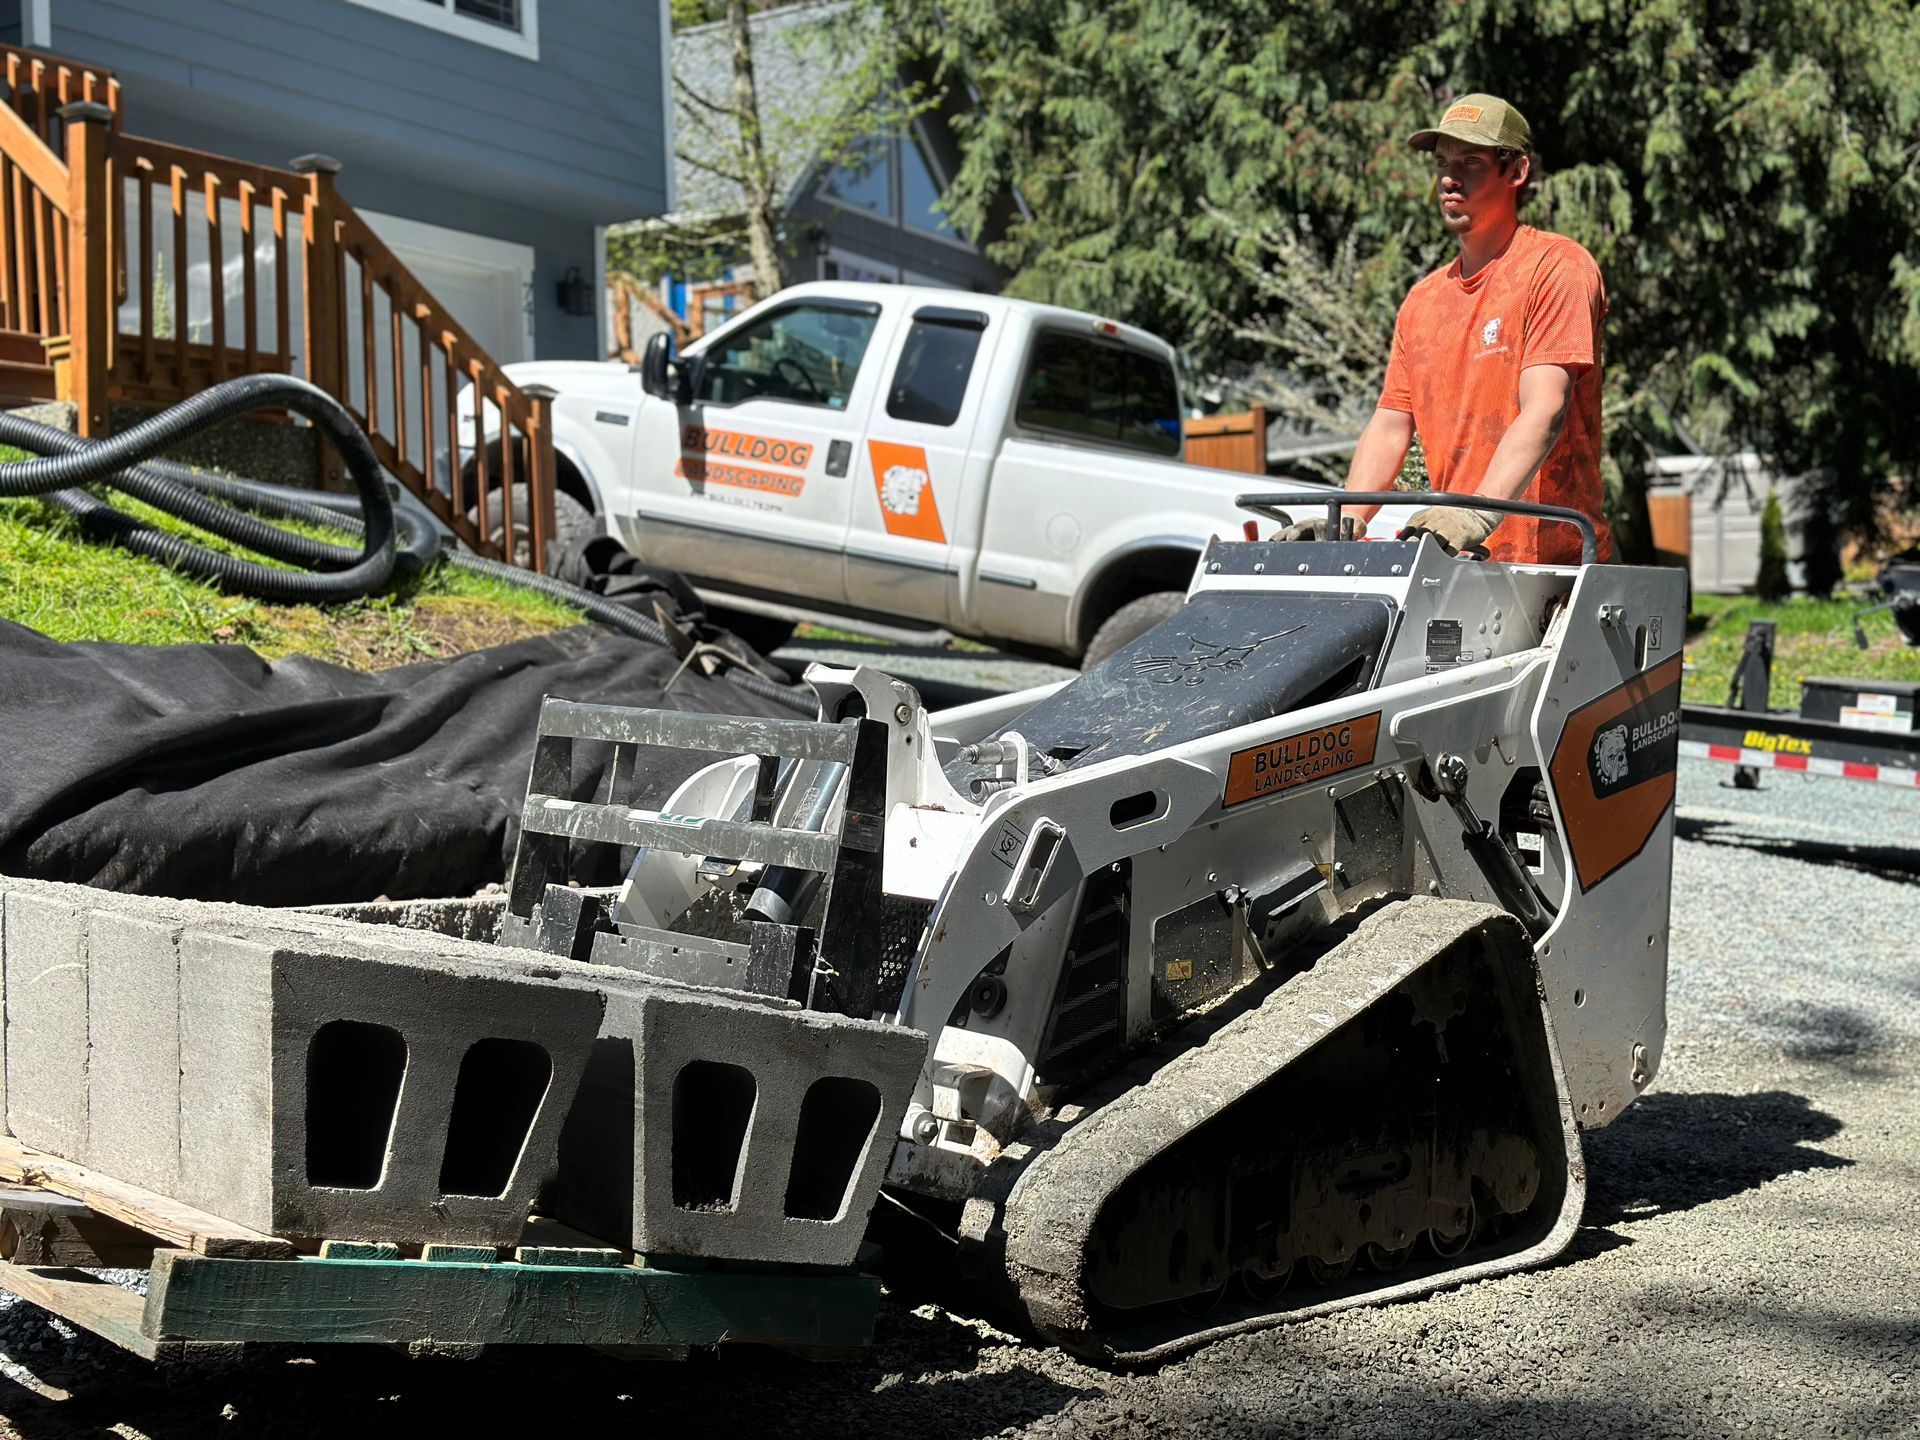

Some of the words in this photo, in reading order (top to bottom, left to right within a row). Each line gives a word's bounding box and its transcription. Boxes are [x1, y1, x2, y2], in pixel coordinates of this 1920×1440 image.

[685, 429, 808, 466] BULLDOG
[1255, 727, 1351, 774] BULLDOG
[1255, 749, 1355, 792] LANDSCAPING
